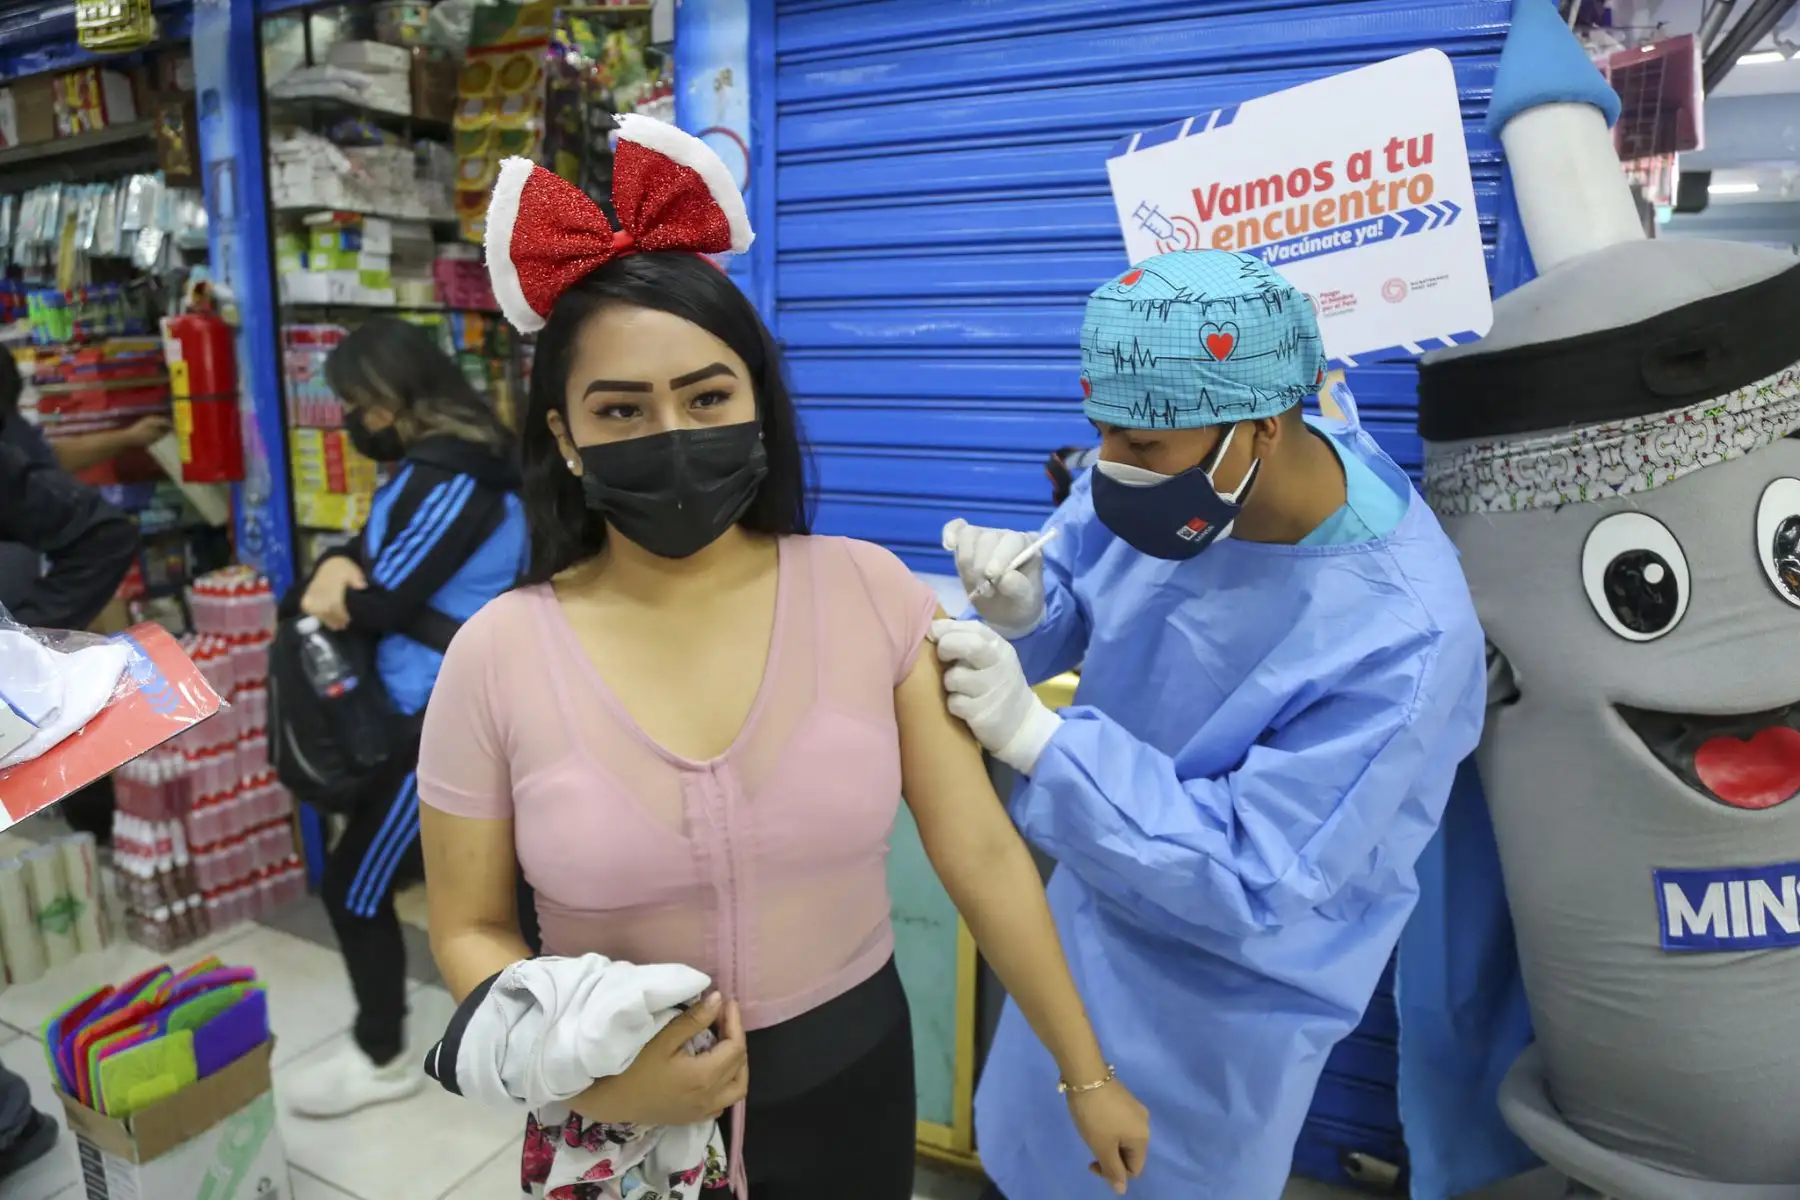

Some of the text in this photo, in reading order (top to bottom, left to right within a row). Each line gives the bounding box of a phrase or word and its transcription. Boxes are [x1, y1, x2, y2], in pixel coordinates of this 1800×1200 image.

[1192, 133, 1434, 223] Vamos a tu
[1211, 173, 1434, 251] encuentro
[1262, 218, 1384, 263] ¡Vacúnate ya!
[1663, 875, 1800, 938] MIN
